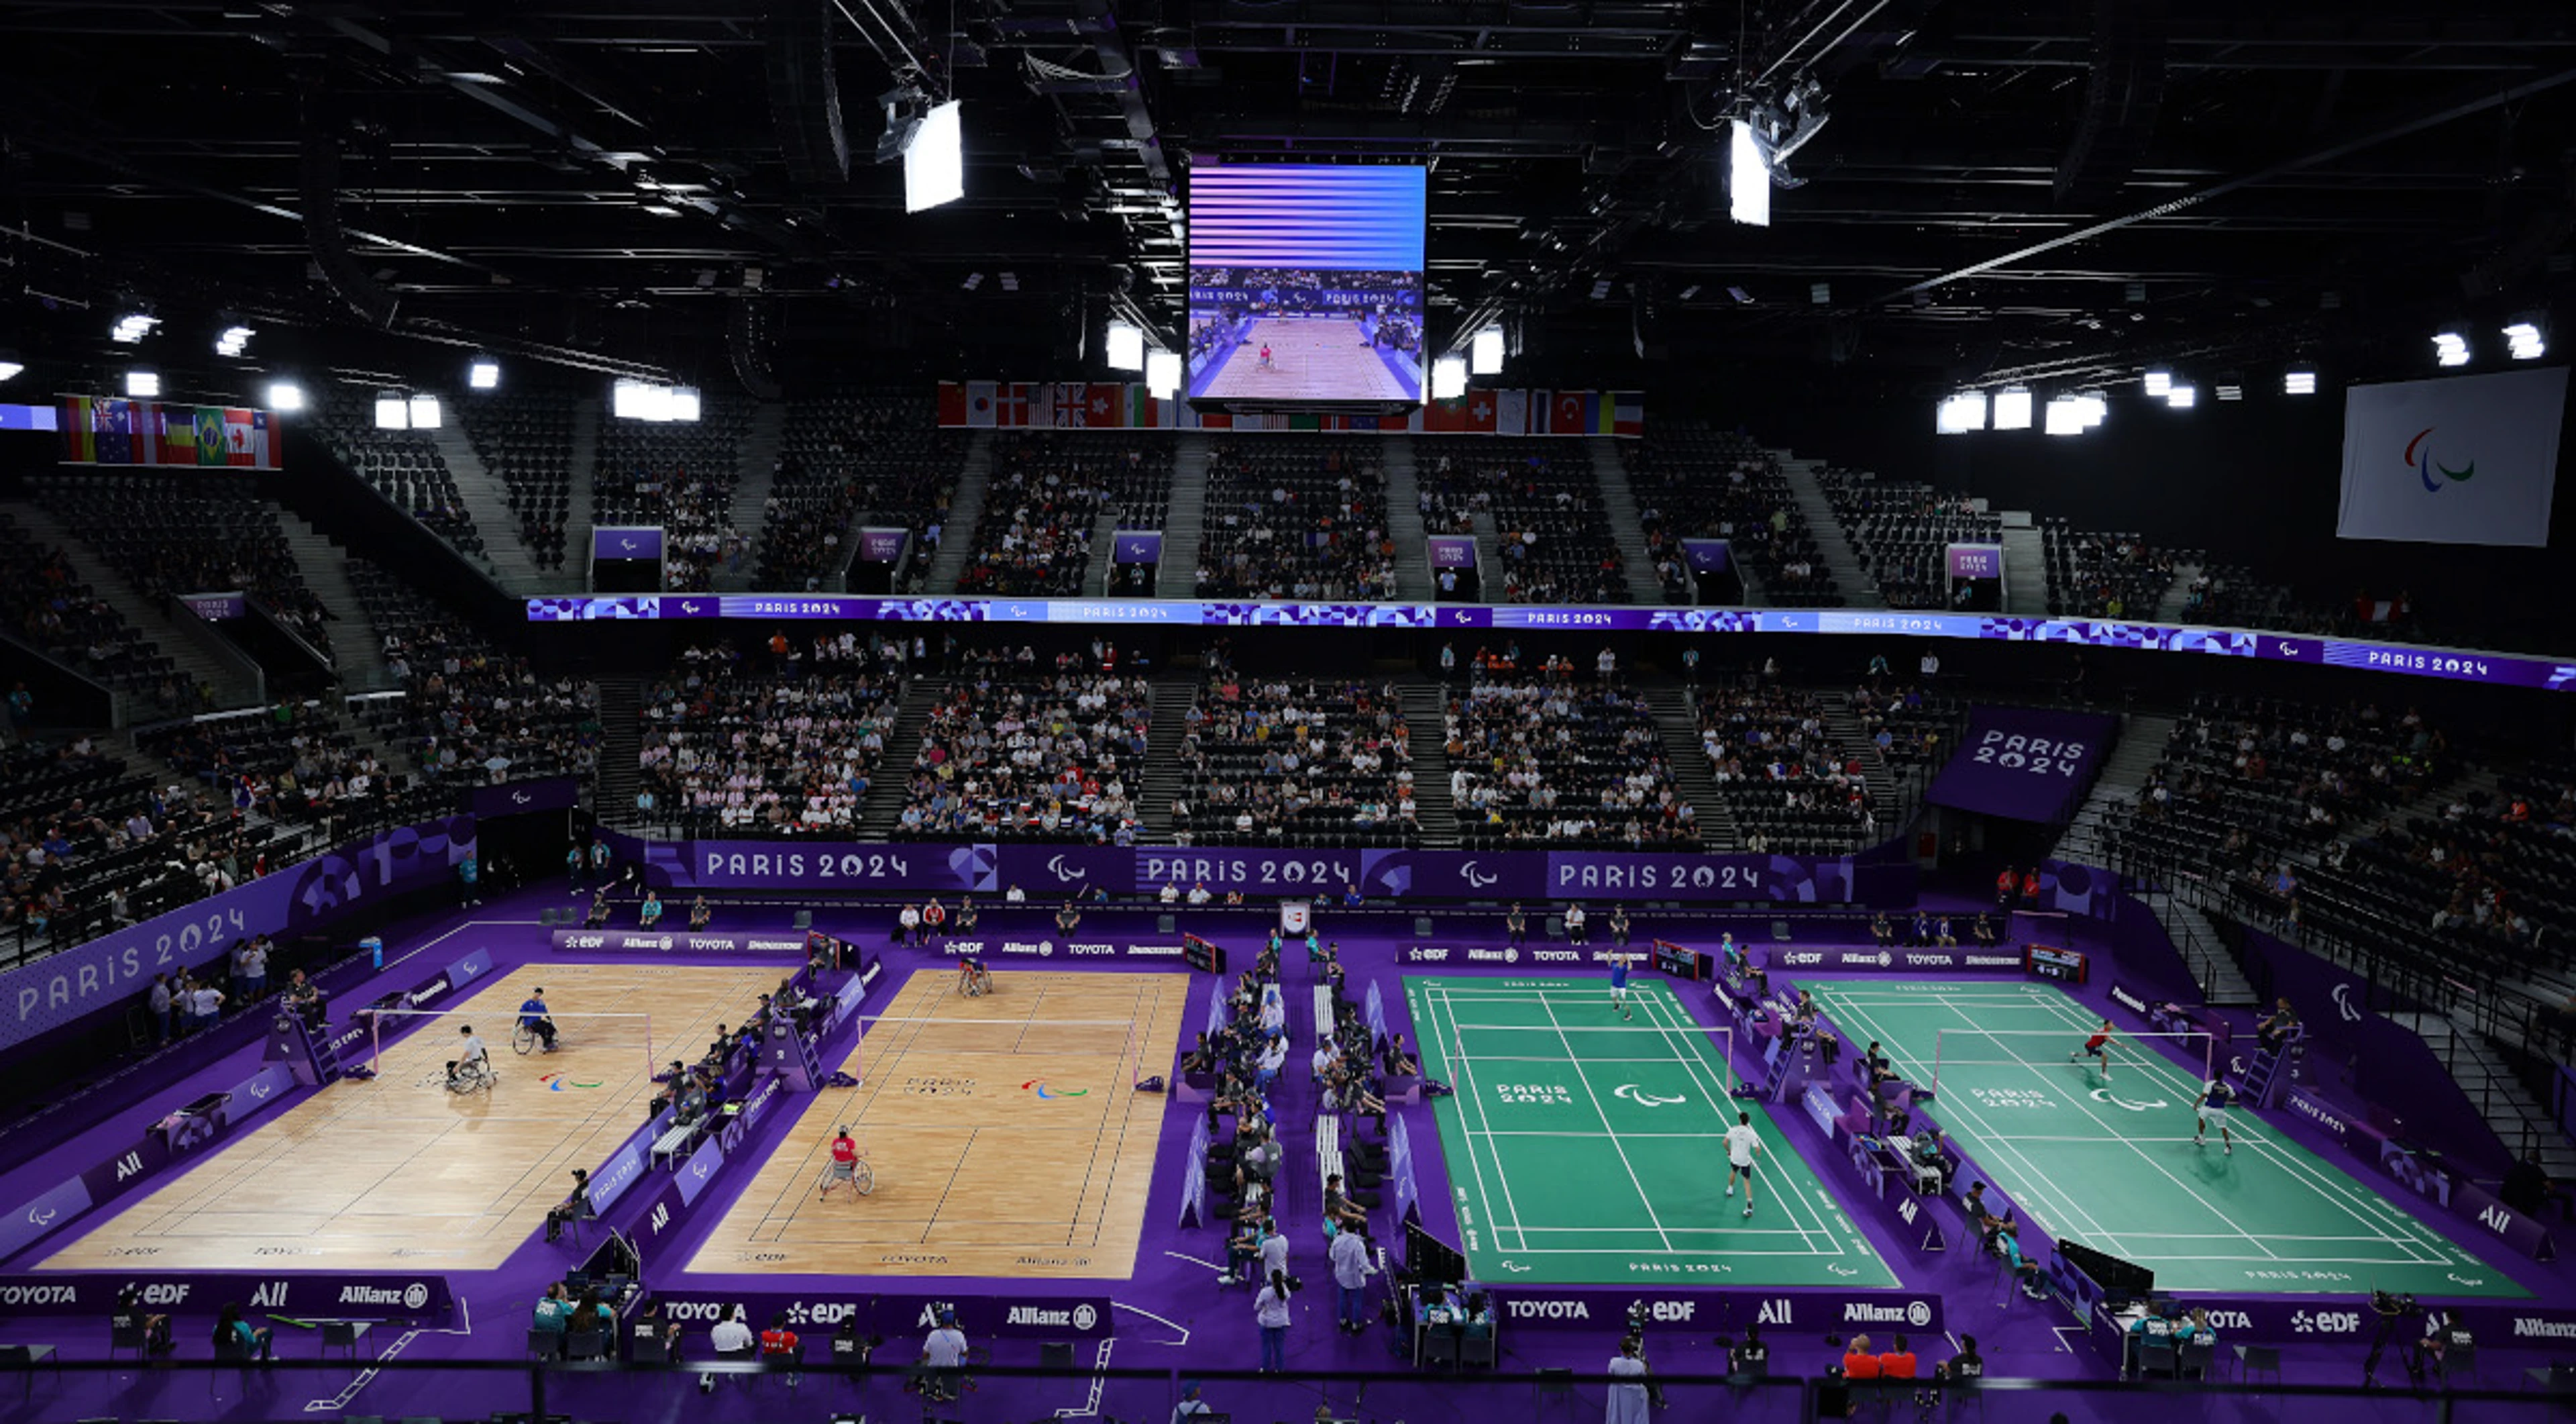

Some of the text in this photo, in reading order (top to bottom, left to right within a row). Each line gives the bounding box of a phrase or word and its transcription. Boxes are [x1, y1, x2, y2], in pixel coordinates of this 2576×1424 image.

[2432, 660, 2489, 676] 2024
[1982, 729, 2084, 759] PARIS
[1973, 747, 2075, 777] 2024
[708, 853, 908, 878] PARIS 2024
[1148, 858, 1349, 884] PARIS 2024
[1560, 864, 1758, 888] PARIS 2024
[689, 938, 735, 950] TOYOTA
[1069, 944, 1115, 954] TOYOTA
[19, 908, 244, 1021] PARIS 2024
[1533, 951, 1580, 961] TOYOTA
[1907, 954, 1952, 965] TOYOTA
[1496, 1084, 1567, 1094] PARIS
[1501, 1093, 1572, 1105] 2024
[116, 1151, 143, 1182] All
[1898, 1197, 1919, 1225] All
[2478, 1205, 2511, 1233] All
[250, 1282, 288, 1307] All
[339, 1286, 401, 1305] Allianz
[665, 1301, 747, 1321] TOYOA
[1007, 1307, 1070, 1326] Allianz
[1507, 1301, 1589, 1318] TOYOTA
[1757, 1299, 1792, 1324] All
[1844, 1303, 1905, 1322] Allianz
